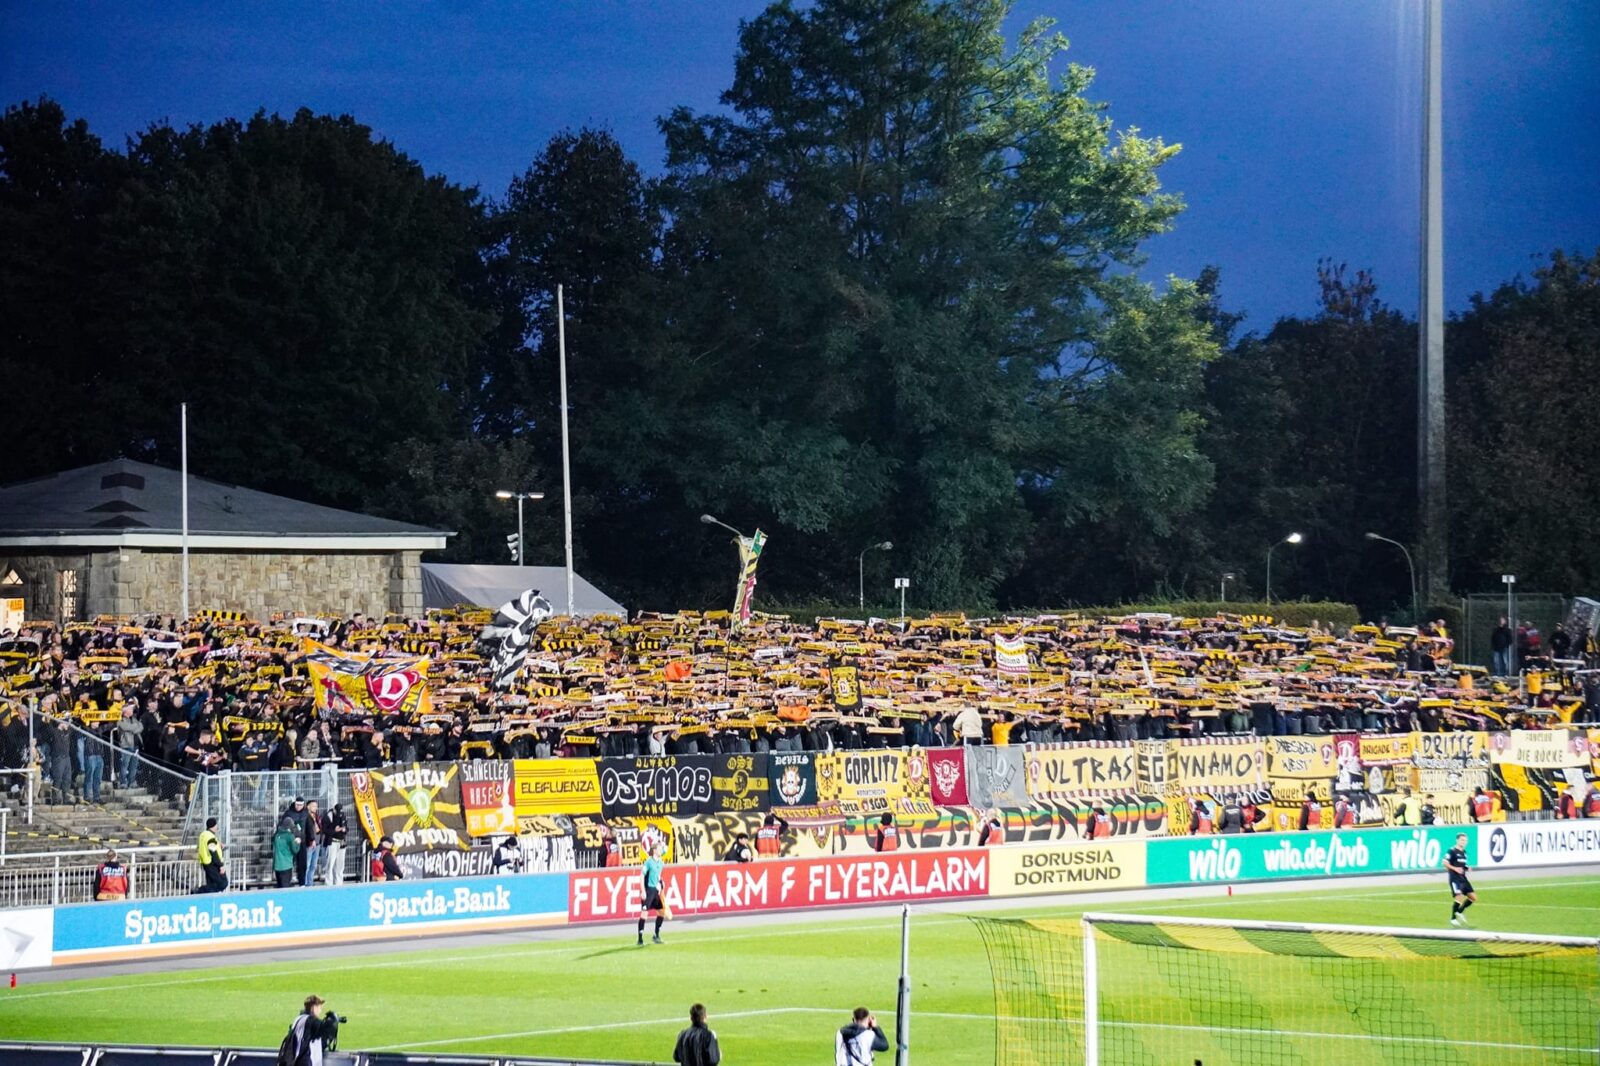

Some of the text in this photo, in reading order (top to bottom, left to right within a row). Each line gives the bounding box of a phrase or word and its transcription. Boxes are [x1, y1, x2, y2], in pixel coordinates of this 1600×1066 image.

[1138, 742, 1175, 755] OFFICIAL
[1422, 734, 1475, 755] DRITTE
[462, 762, 510, 782] SCHNELLER
[775, 755, 809, 765] DEVILS
[844, 753, 899, 785] GÖRLITZ
[1045, 752, 1133, 785] ULTRAS
[1179, 750, 1253, 779] YNAMO
[1137, 751, 1179, 782] SGD
[382, 768, 449, 793] FREITAL
[868, 797, 889, 811] SGD
[392, 828, 459, 848] ON TOUR
[584, 827, 603, 848] 53
[1520, 829, 1600, 853] WIR MACHEN
[424, 850, 493, 877] WALDHEIM
[1022, 850, 1114, 868] BORUSSIA
[1188, 829, 1441, 881] wilo wilo.de/bvb wilo
[573, 868, 768, 917] FLYEALARM
[809, 856, 986, 902] FLYERALARM
[1014, 866, 1121, 885] DORTMUND
[369, 885, 511, 925] Sparda-Bank
[125, 900, 283, 944] Sparda-Bank
